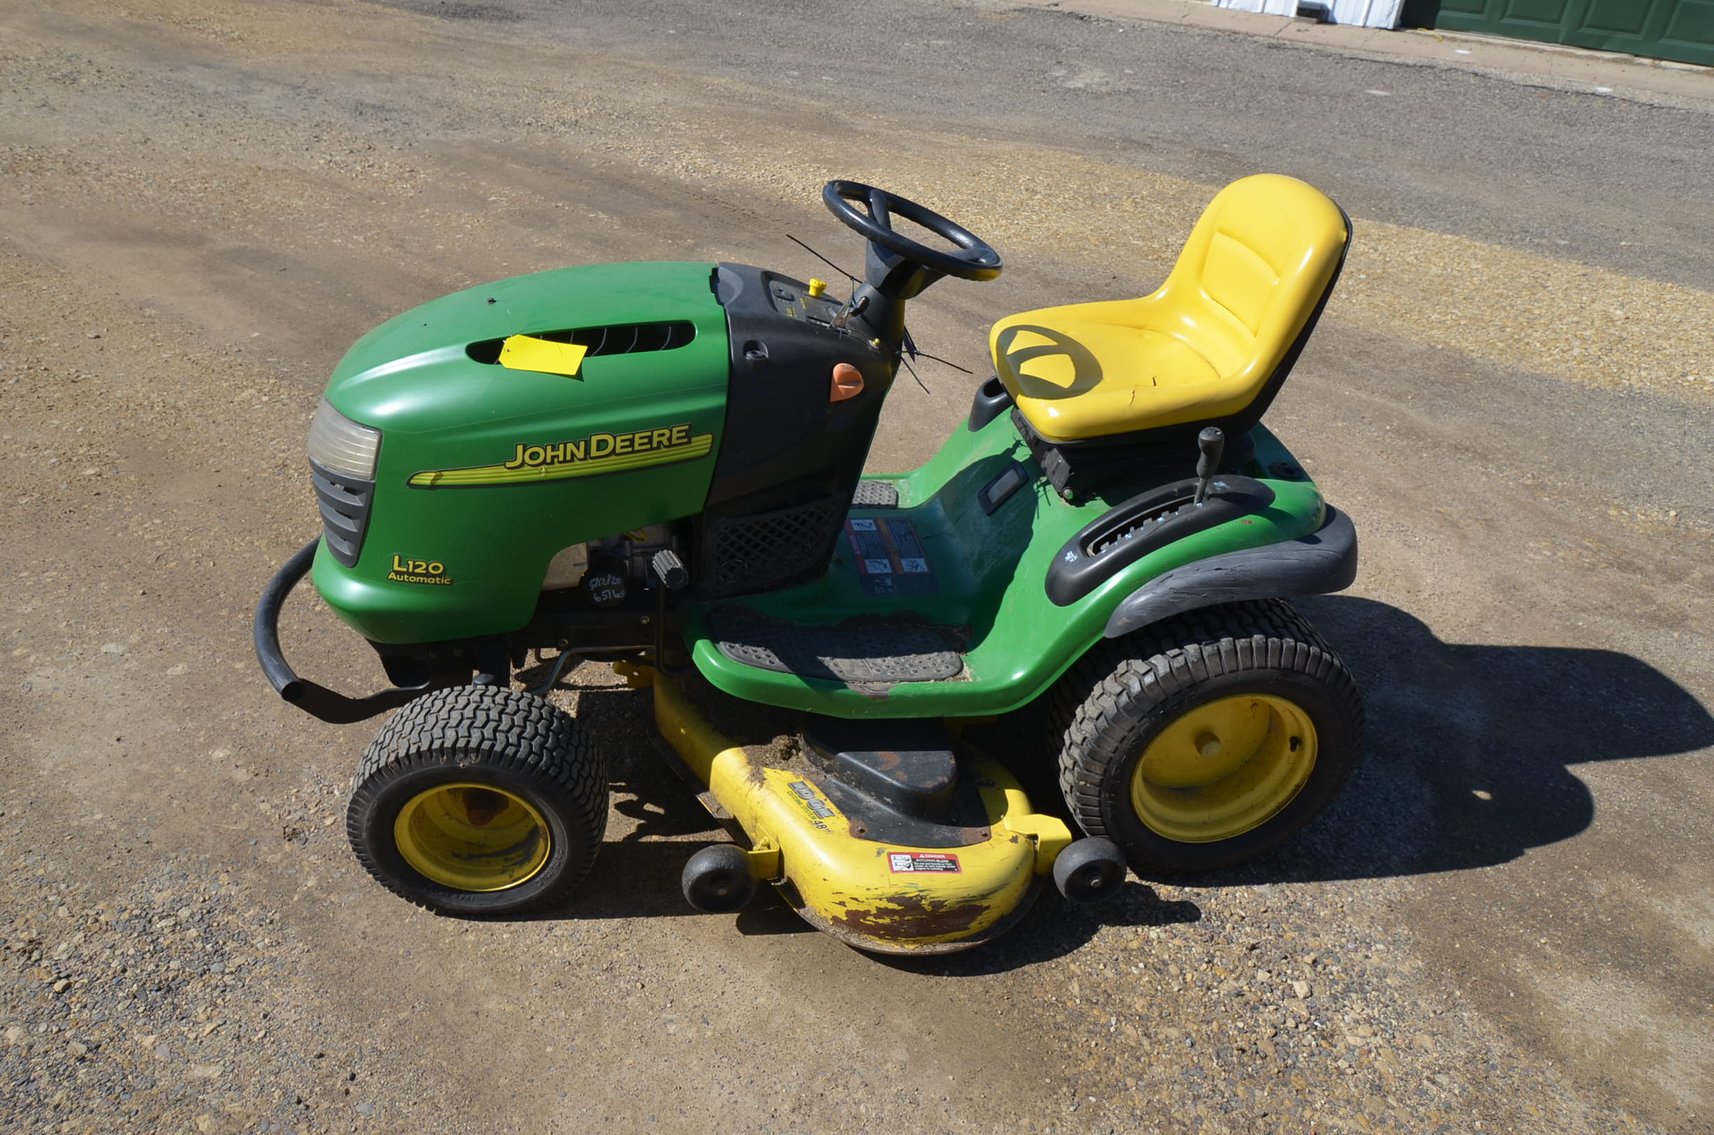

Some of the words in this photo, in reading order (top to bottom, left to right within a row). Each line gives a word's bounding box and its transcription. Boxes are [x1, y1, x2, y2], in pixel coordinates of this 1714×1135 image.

[505, 439, 586, 469] JOHN
[589, 424, 691, 458] DEERE
[387, 572, 453, 586] Automatic
[392, 554, 446, 576] L120
[787, 780, 836, 820] EDGE
